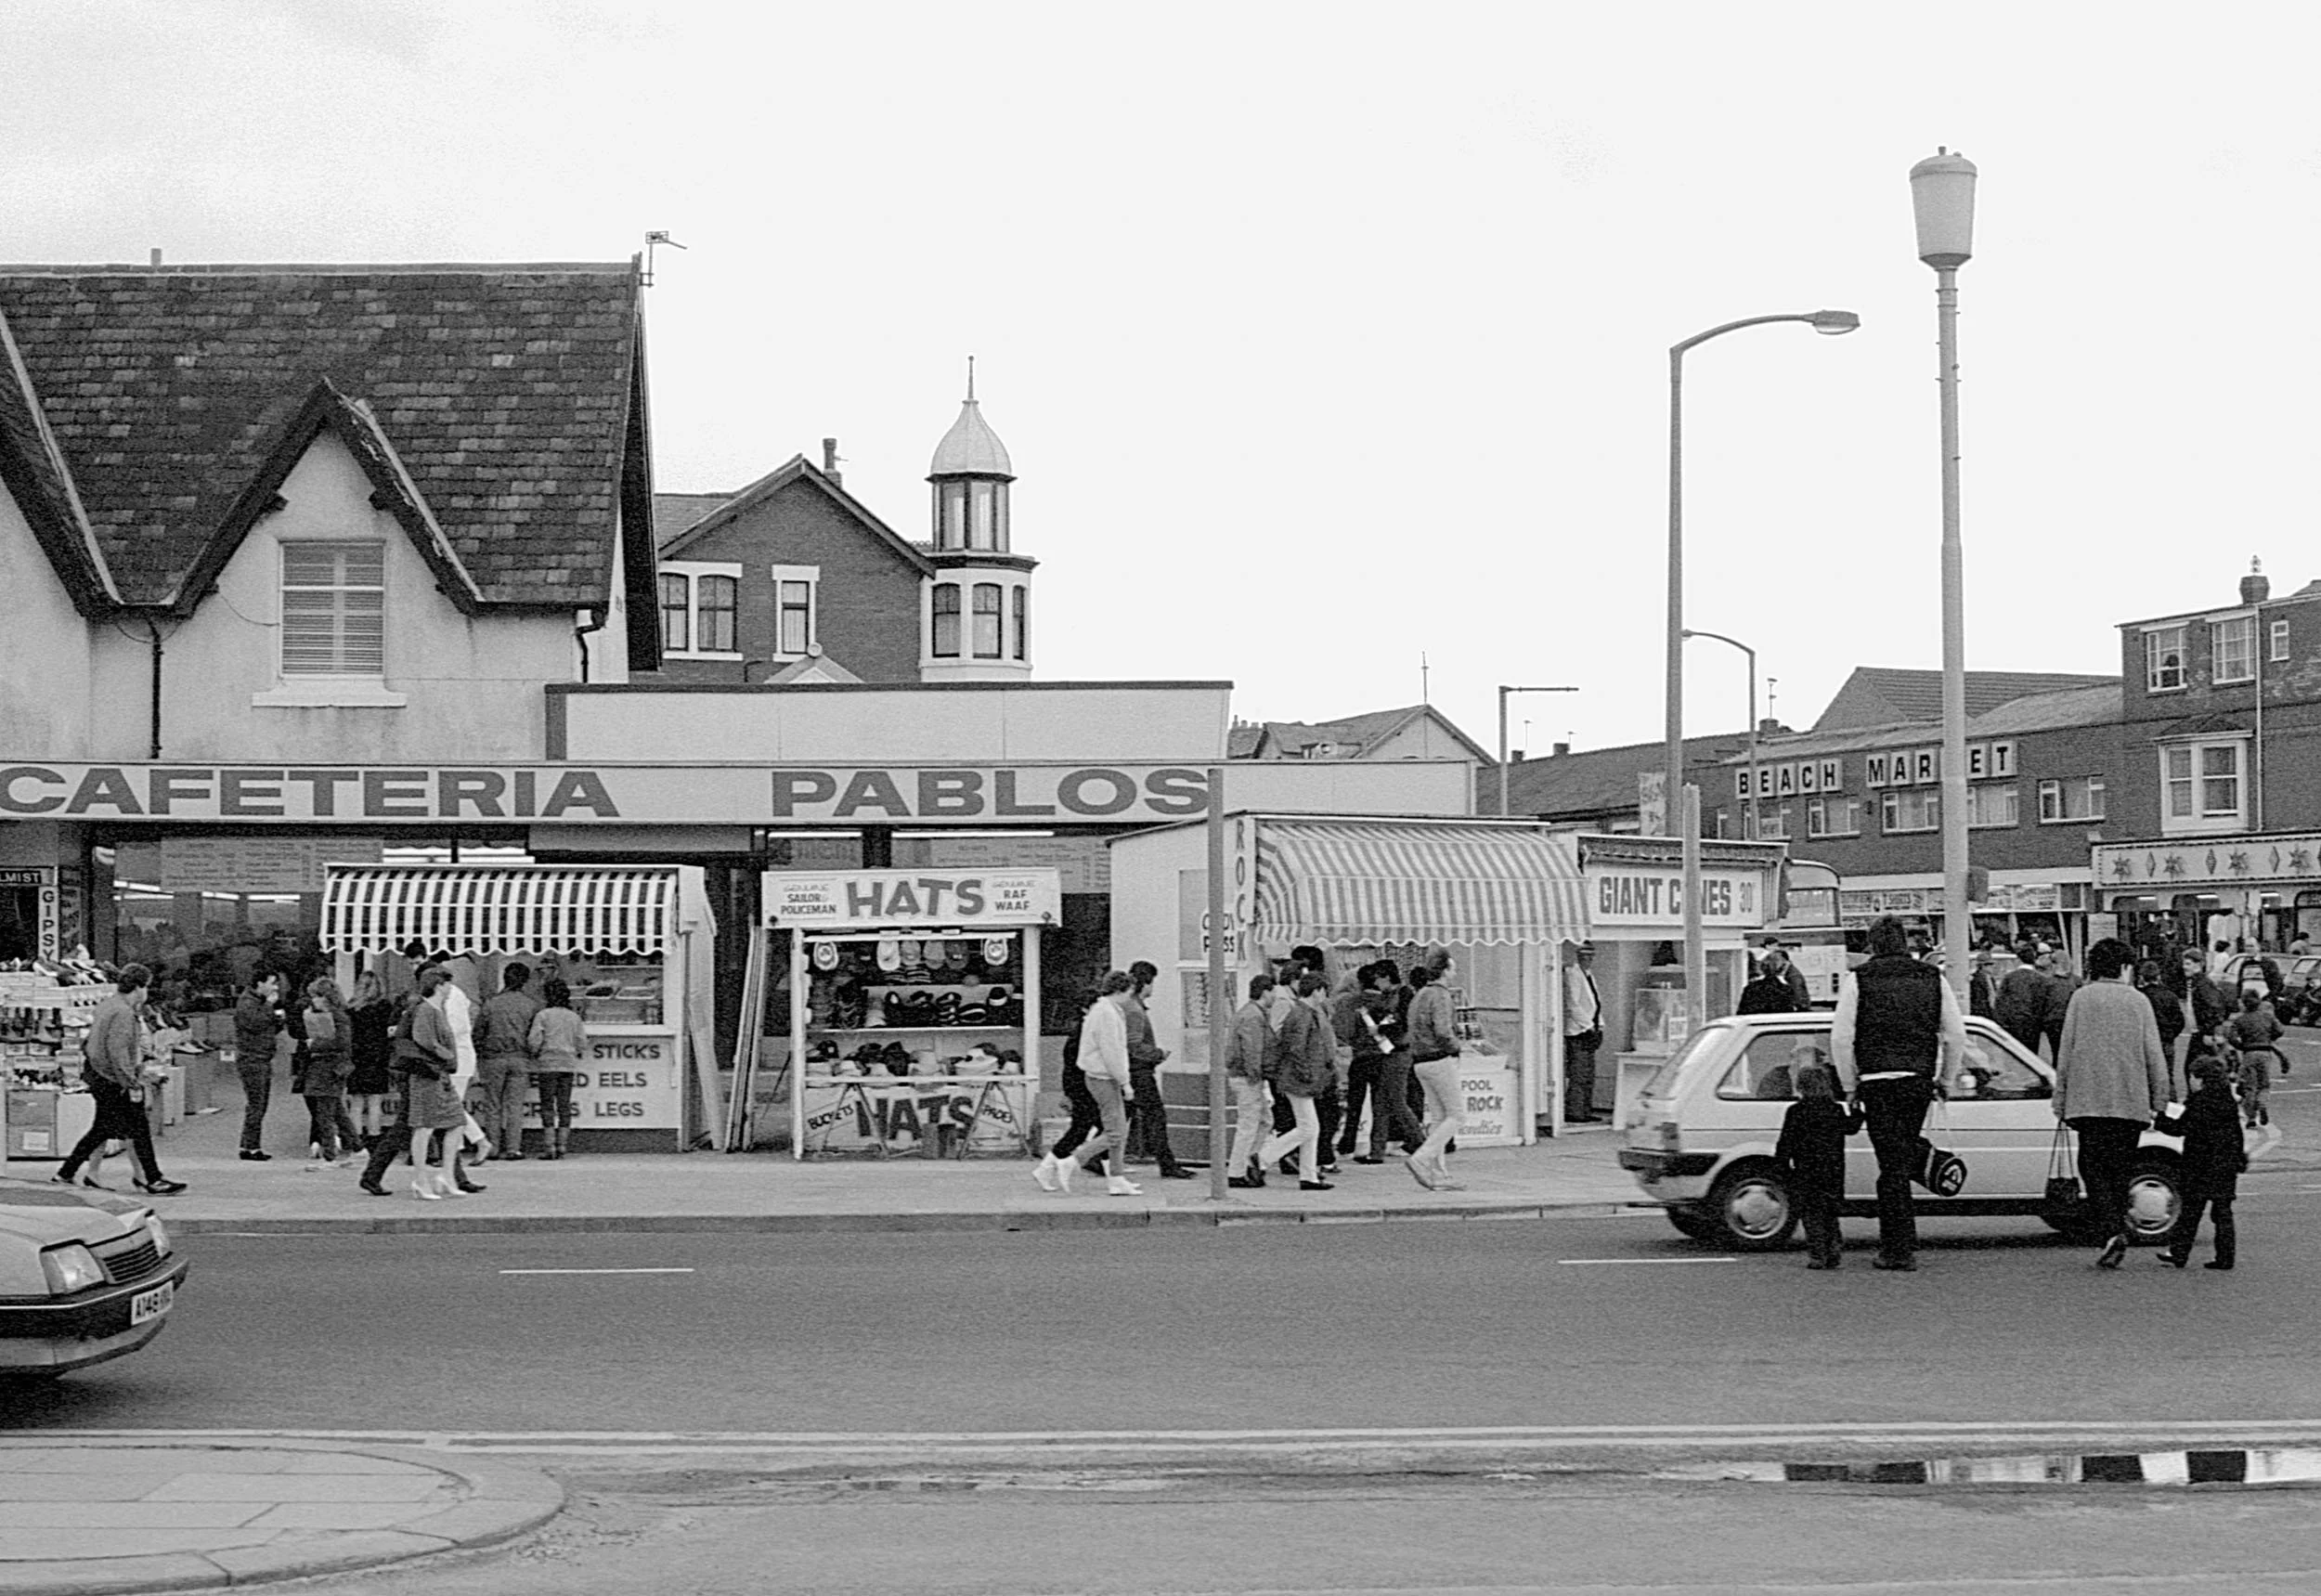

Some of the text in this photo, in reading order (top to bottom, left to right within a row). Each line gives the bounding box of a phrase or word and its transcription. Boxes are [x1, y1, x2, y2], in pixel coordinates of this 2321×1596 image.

[1738, 746, 2009, 796] BEACH MARET
[0, 766, 621, 818] CAFETERIA
[772, 768, 1209, 817] PABLOS
[787, 893, 821, 902] SAILOR
[846, 877, 984, 917] HATS
[1004, 889, 1028, 899] RAF
[1236, 819, 1247, 961] ROCK
[1600, 876, 1663, 915] GIANT
[781, 904, 836, 915] POLICEMAN
[994, 901, 1031, 911] WAAF
[42, 890, 54, 961] GIPSY
[1203, 936, 1235, 953] FSS
[593, 1044, 661, 1059] STICKS
[599, 1072, 647, 1087] EELS
[595, 1102, 644, 1117] LEGS
[1467, 1096, 1504, 1111] ROCK
[855, 1095, 975, 1141] HATS
